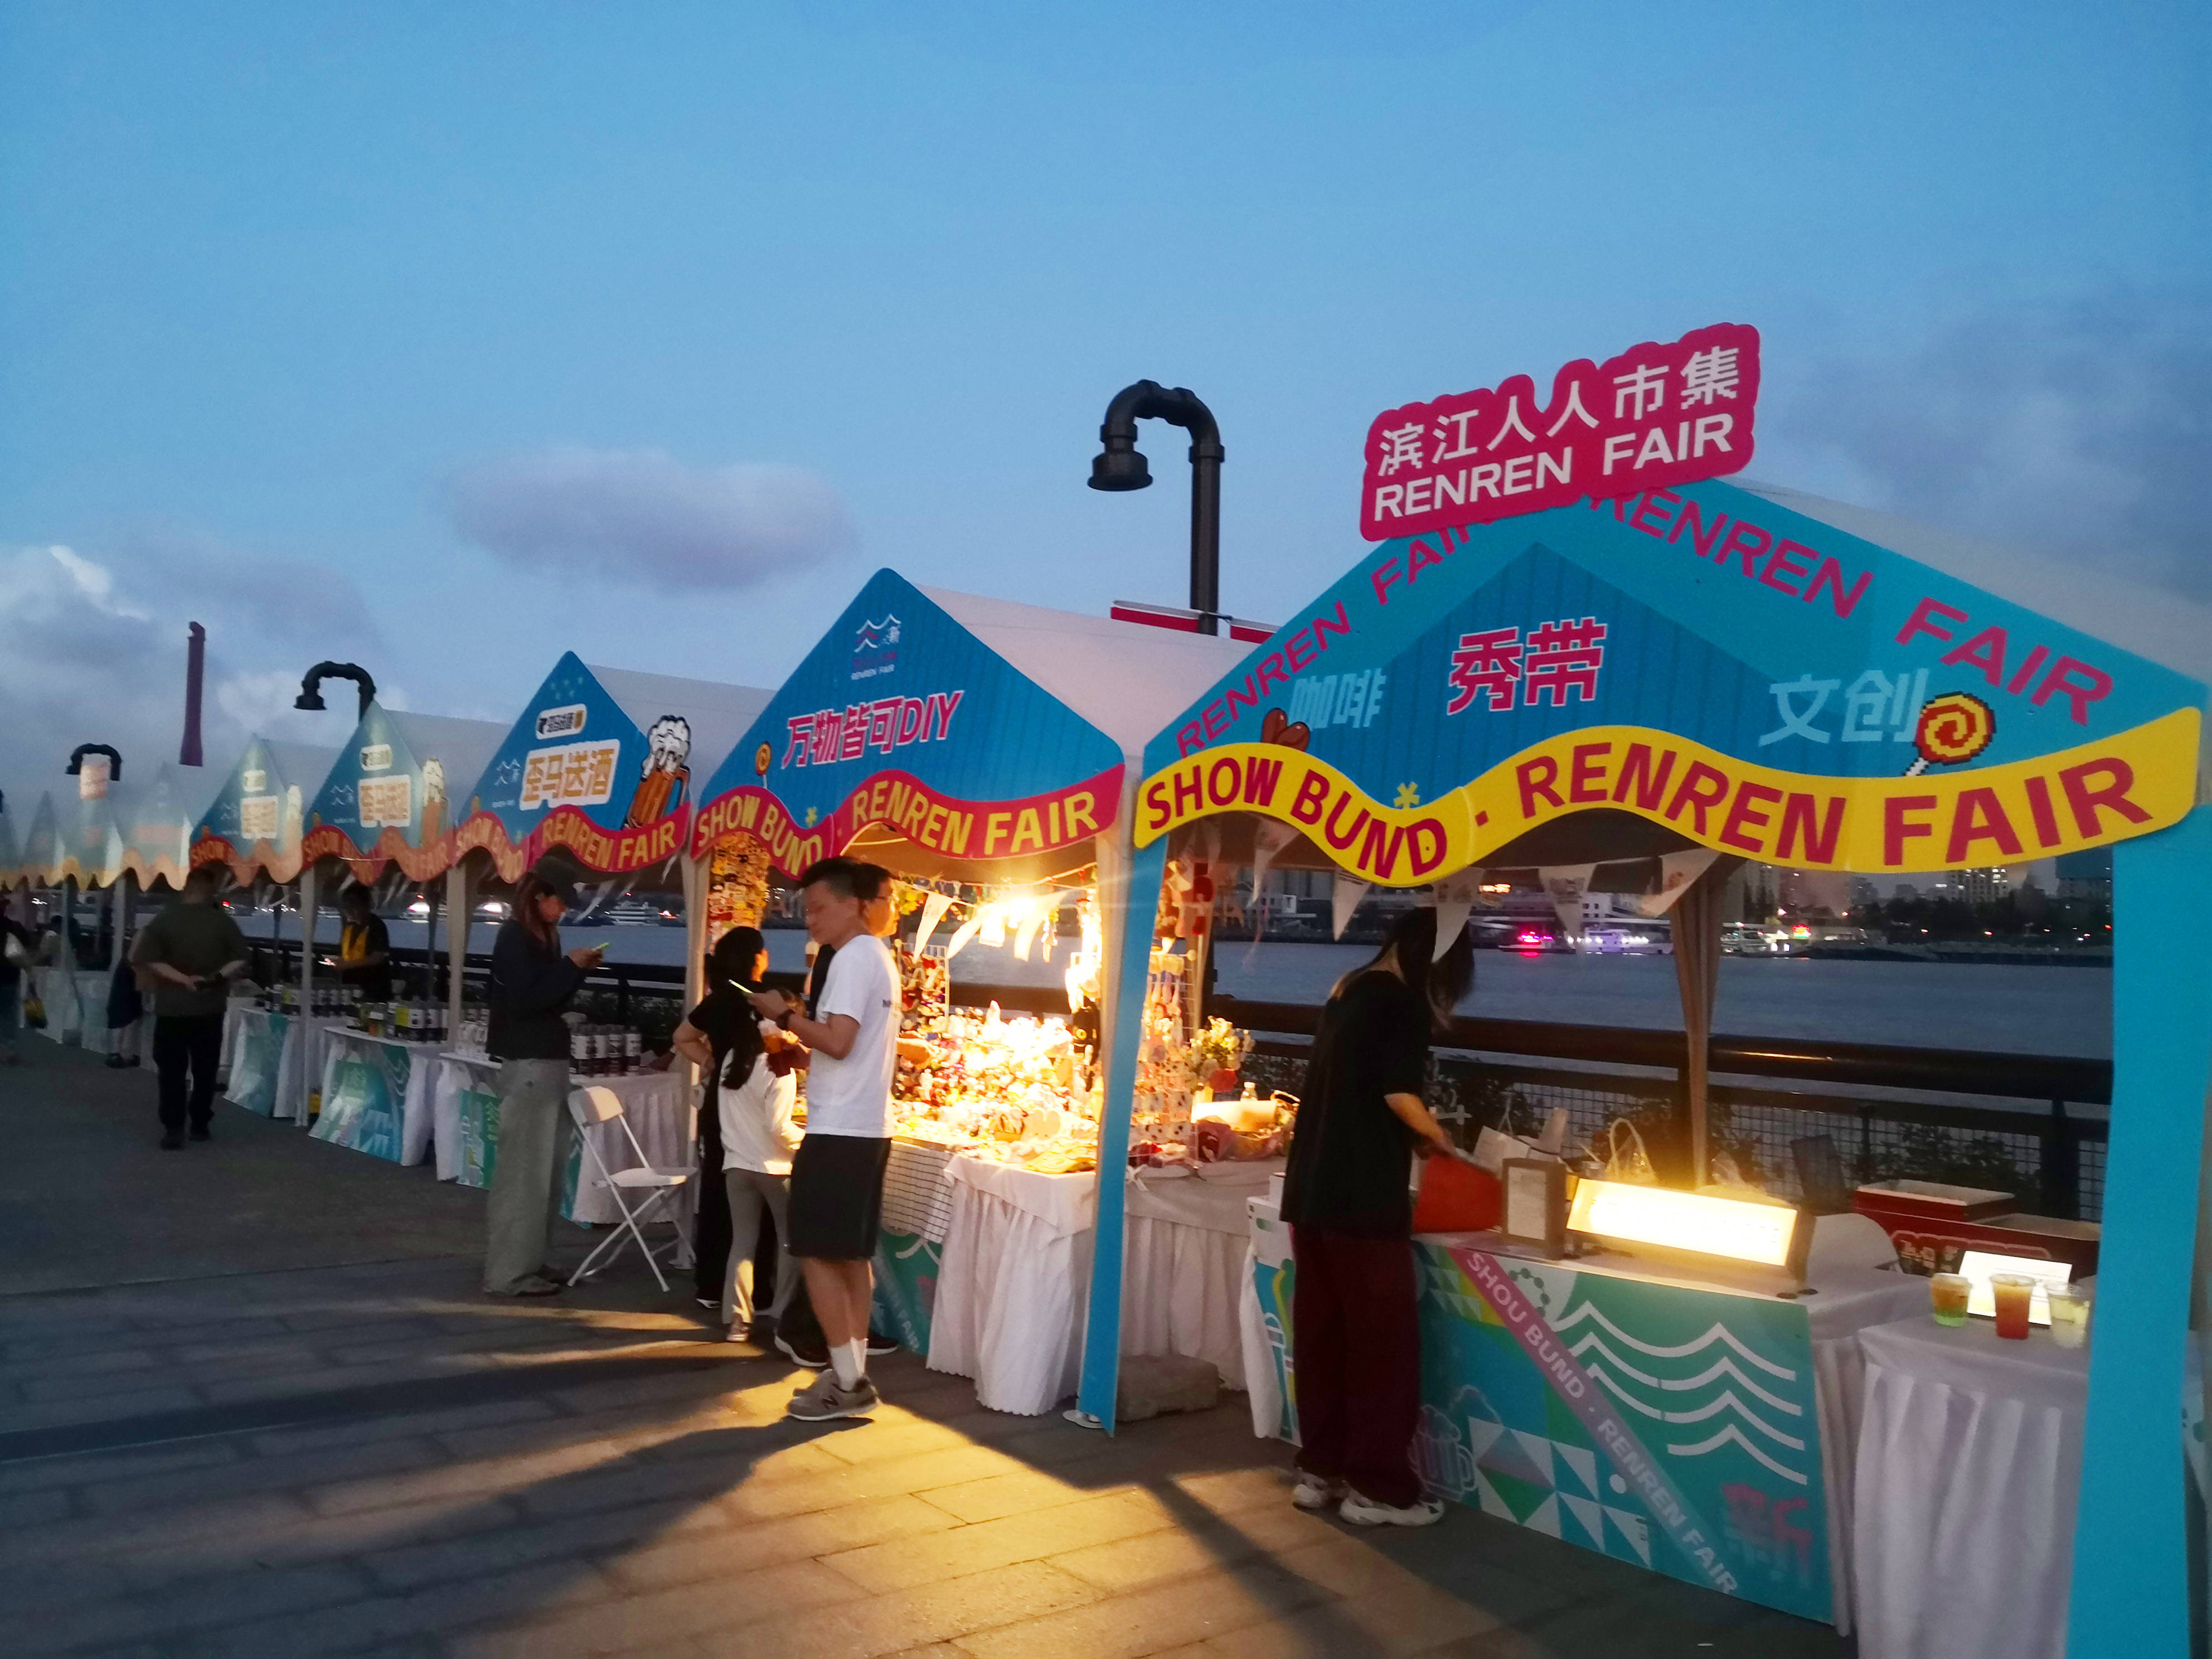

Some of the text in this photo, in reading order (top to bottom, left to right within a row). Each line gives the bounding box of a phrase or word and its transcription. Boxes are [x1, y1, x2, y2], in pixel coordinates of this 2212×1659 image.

[1378, 345, 1740, 477] 滨江人人市集
[1374, 413, 1734, 522] RENREN FAIR
[1176, 600, 1351, 759] RENREN
[1288, 668, 1386, 731] 咖啡
[1447, 616, 1607, 715] 秀带
[1758, 669, 1928, 747] 文创
[1895, 596, 2114, 726] FAIR
[781, 690, 964, 769] 万物皆可DIY
[541, 812, 613, 869] RENREN
[618, 821, 676, 869] FAIR
[698, 780, 1098, 876] SHOW BUND RENREN FAIR
[1147, 741, 2153, 879] SHOW BUND RENREN FAIR
[1467, 1253, 1738, 1593] SHOU BUND RENREN FAIR
